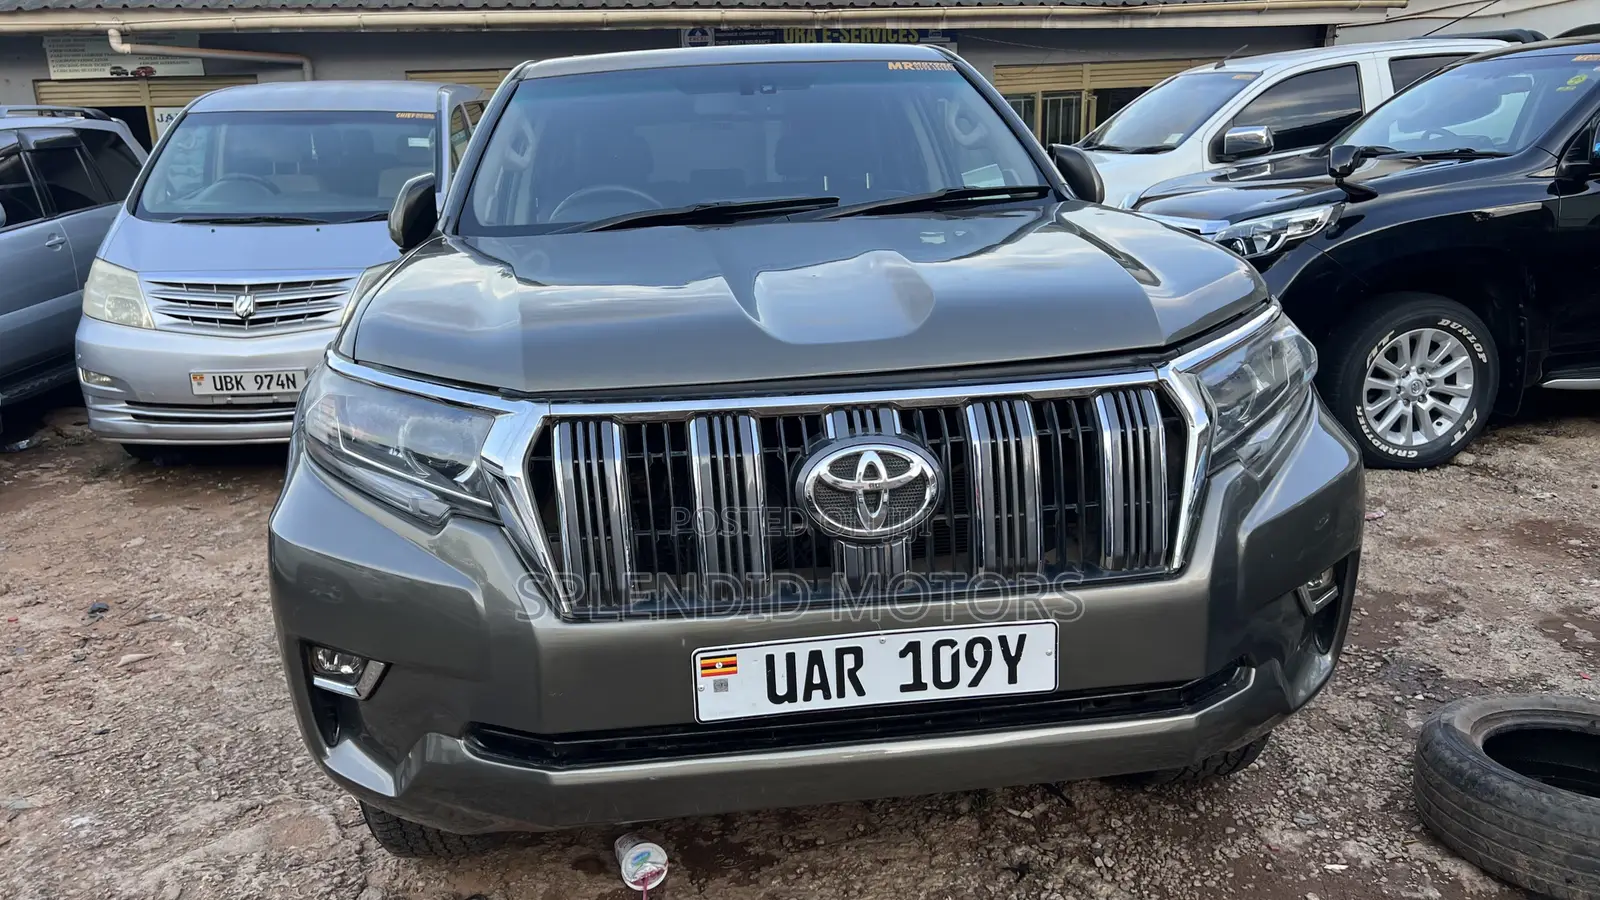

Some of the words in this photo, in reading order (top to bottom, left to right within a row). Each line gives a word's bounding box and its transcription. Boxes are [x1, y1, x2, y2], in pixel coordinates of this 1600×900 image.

[822, 27, 919, 43] E-SERVICES
[888, 61, 914, 70] MR
[1437, 318, 1488, 364] DUNLOP
[212, 375, 246, 391] UBK
[254, 373, 297, 390] 974N
[1355, 405, 1420, 458] GRANDTREK
[765, 646, 867, 705] UAR
[898, 633, 1027, 693] 109Y
